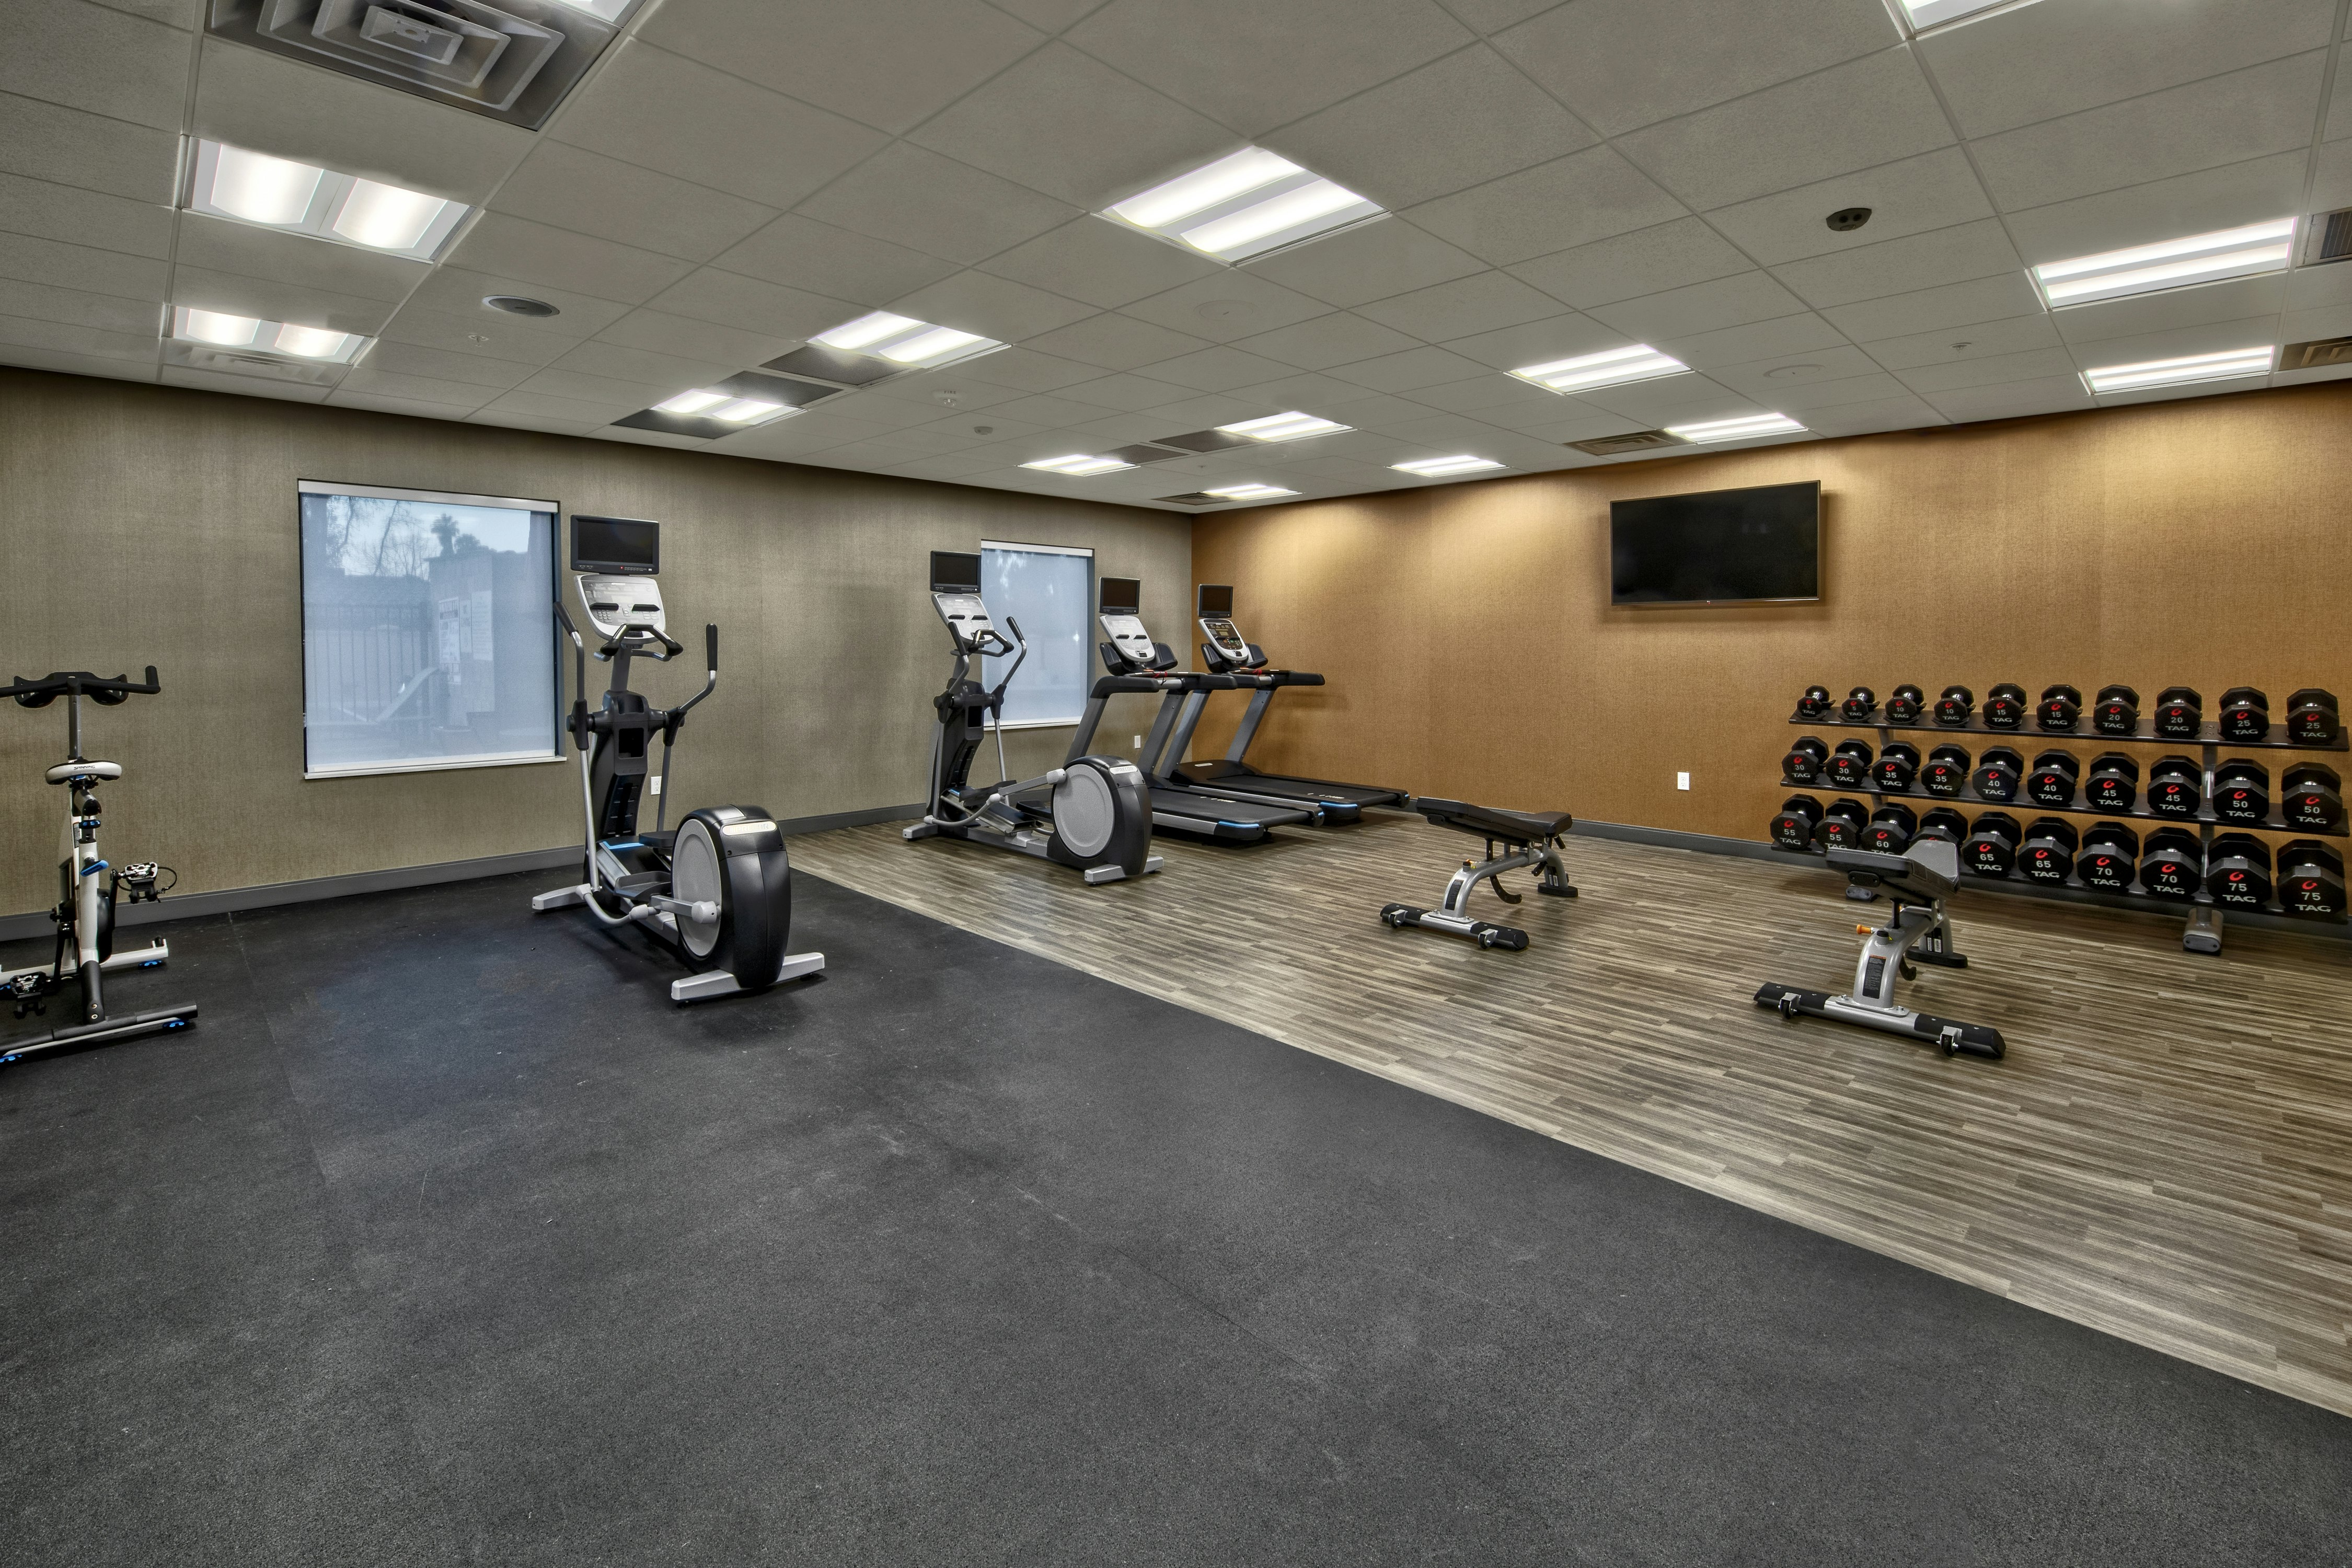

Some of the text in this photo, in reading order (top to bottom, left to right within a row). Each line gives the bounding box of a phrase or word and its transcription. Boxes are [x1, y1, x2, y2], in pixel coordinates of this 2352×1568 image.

[735, 823, 768, 832] PREOR
[2161, 874, 2177, 883] 70
[2153, 885, 2185, 894] TAG
